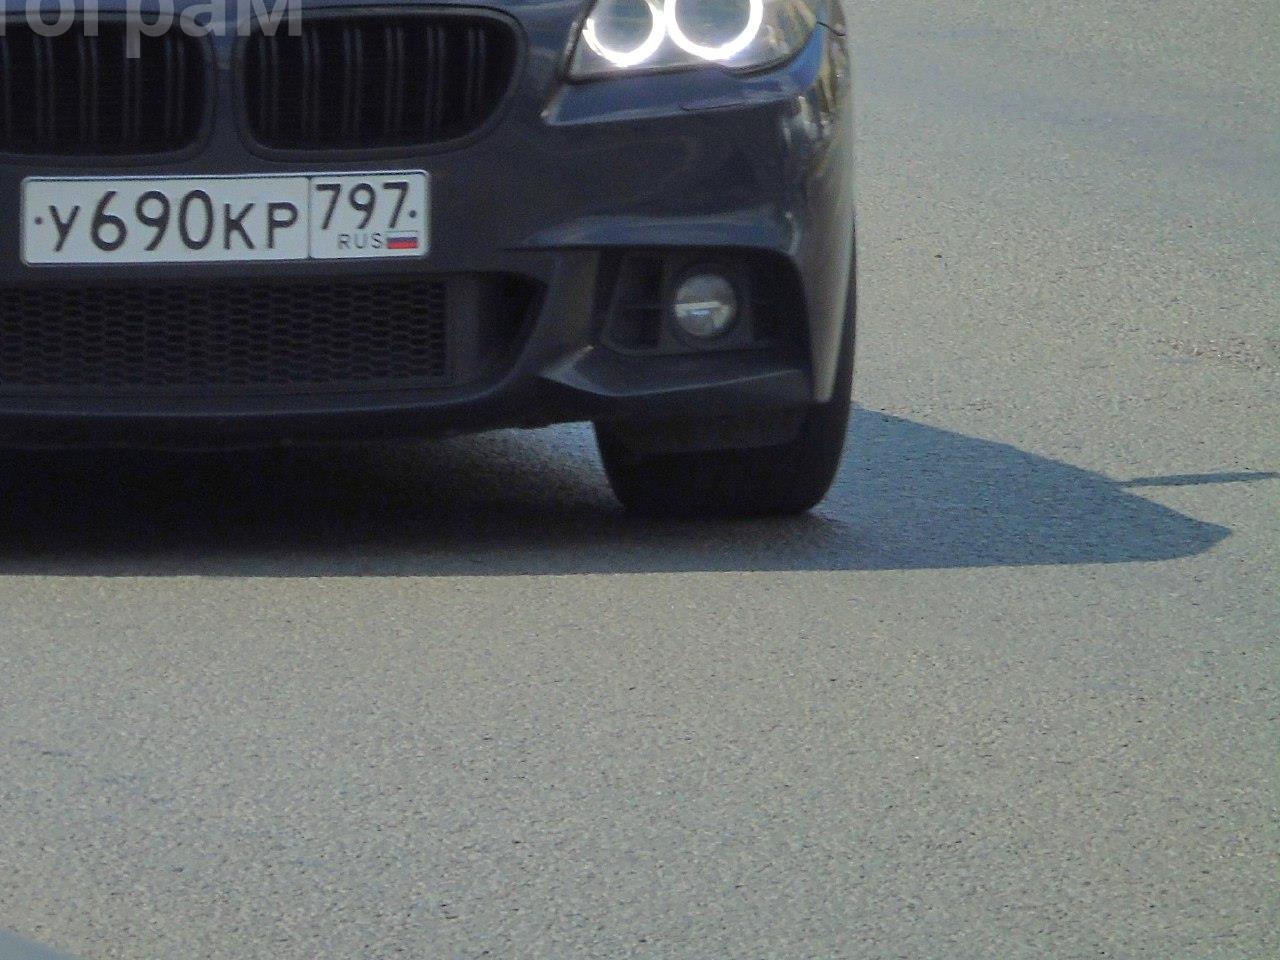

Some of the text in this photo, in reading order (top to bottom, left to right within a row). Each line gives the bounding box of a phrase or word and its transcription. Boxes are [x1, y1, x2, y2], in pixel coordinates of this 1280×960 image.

[48, 182, 411, 253] У690КР 797
[337, 232, 383, 251] RUS
